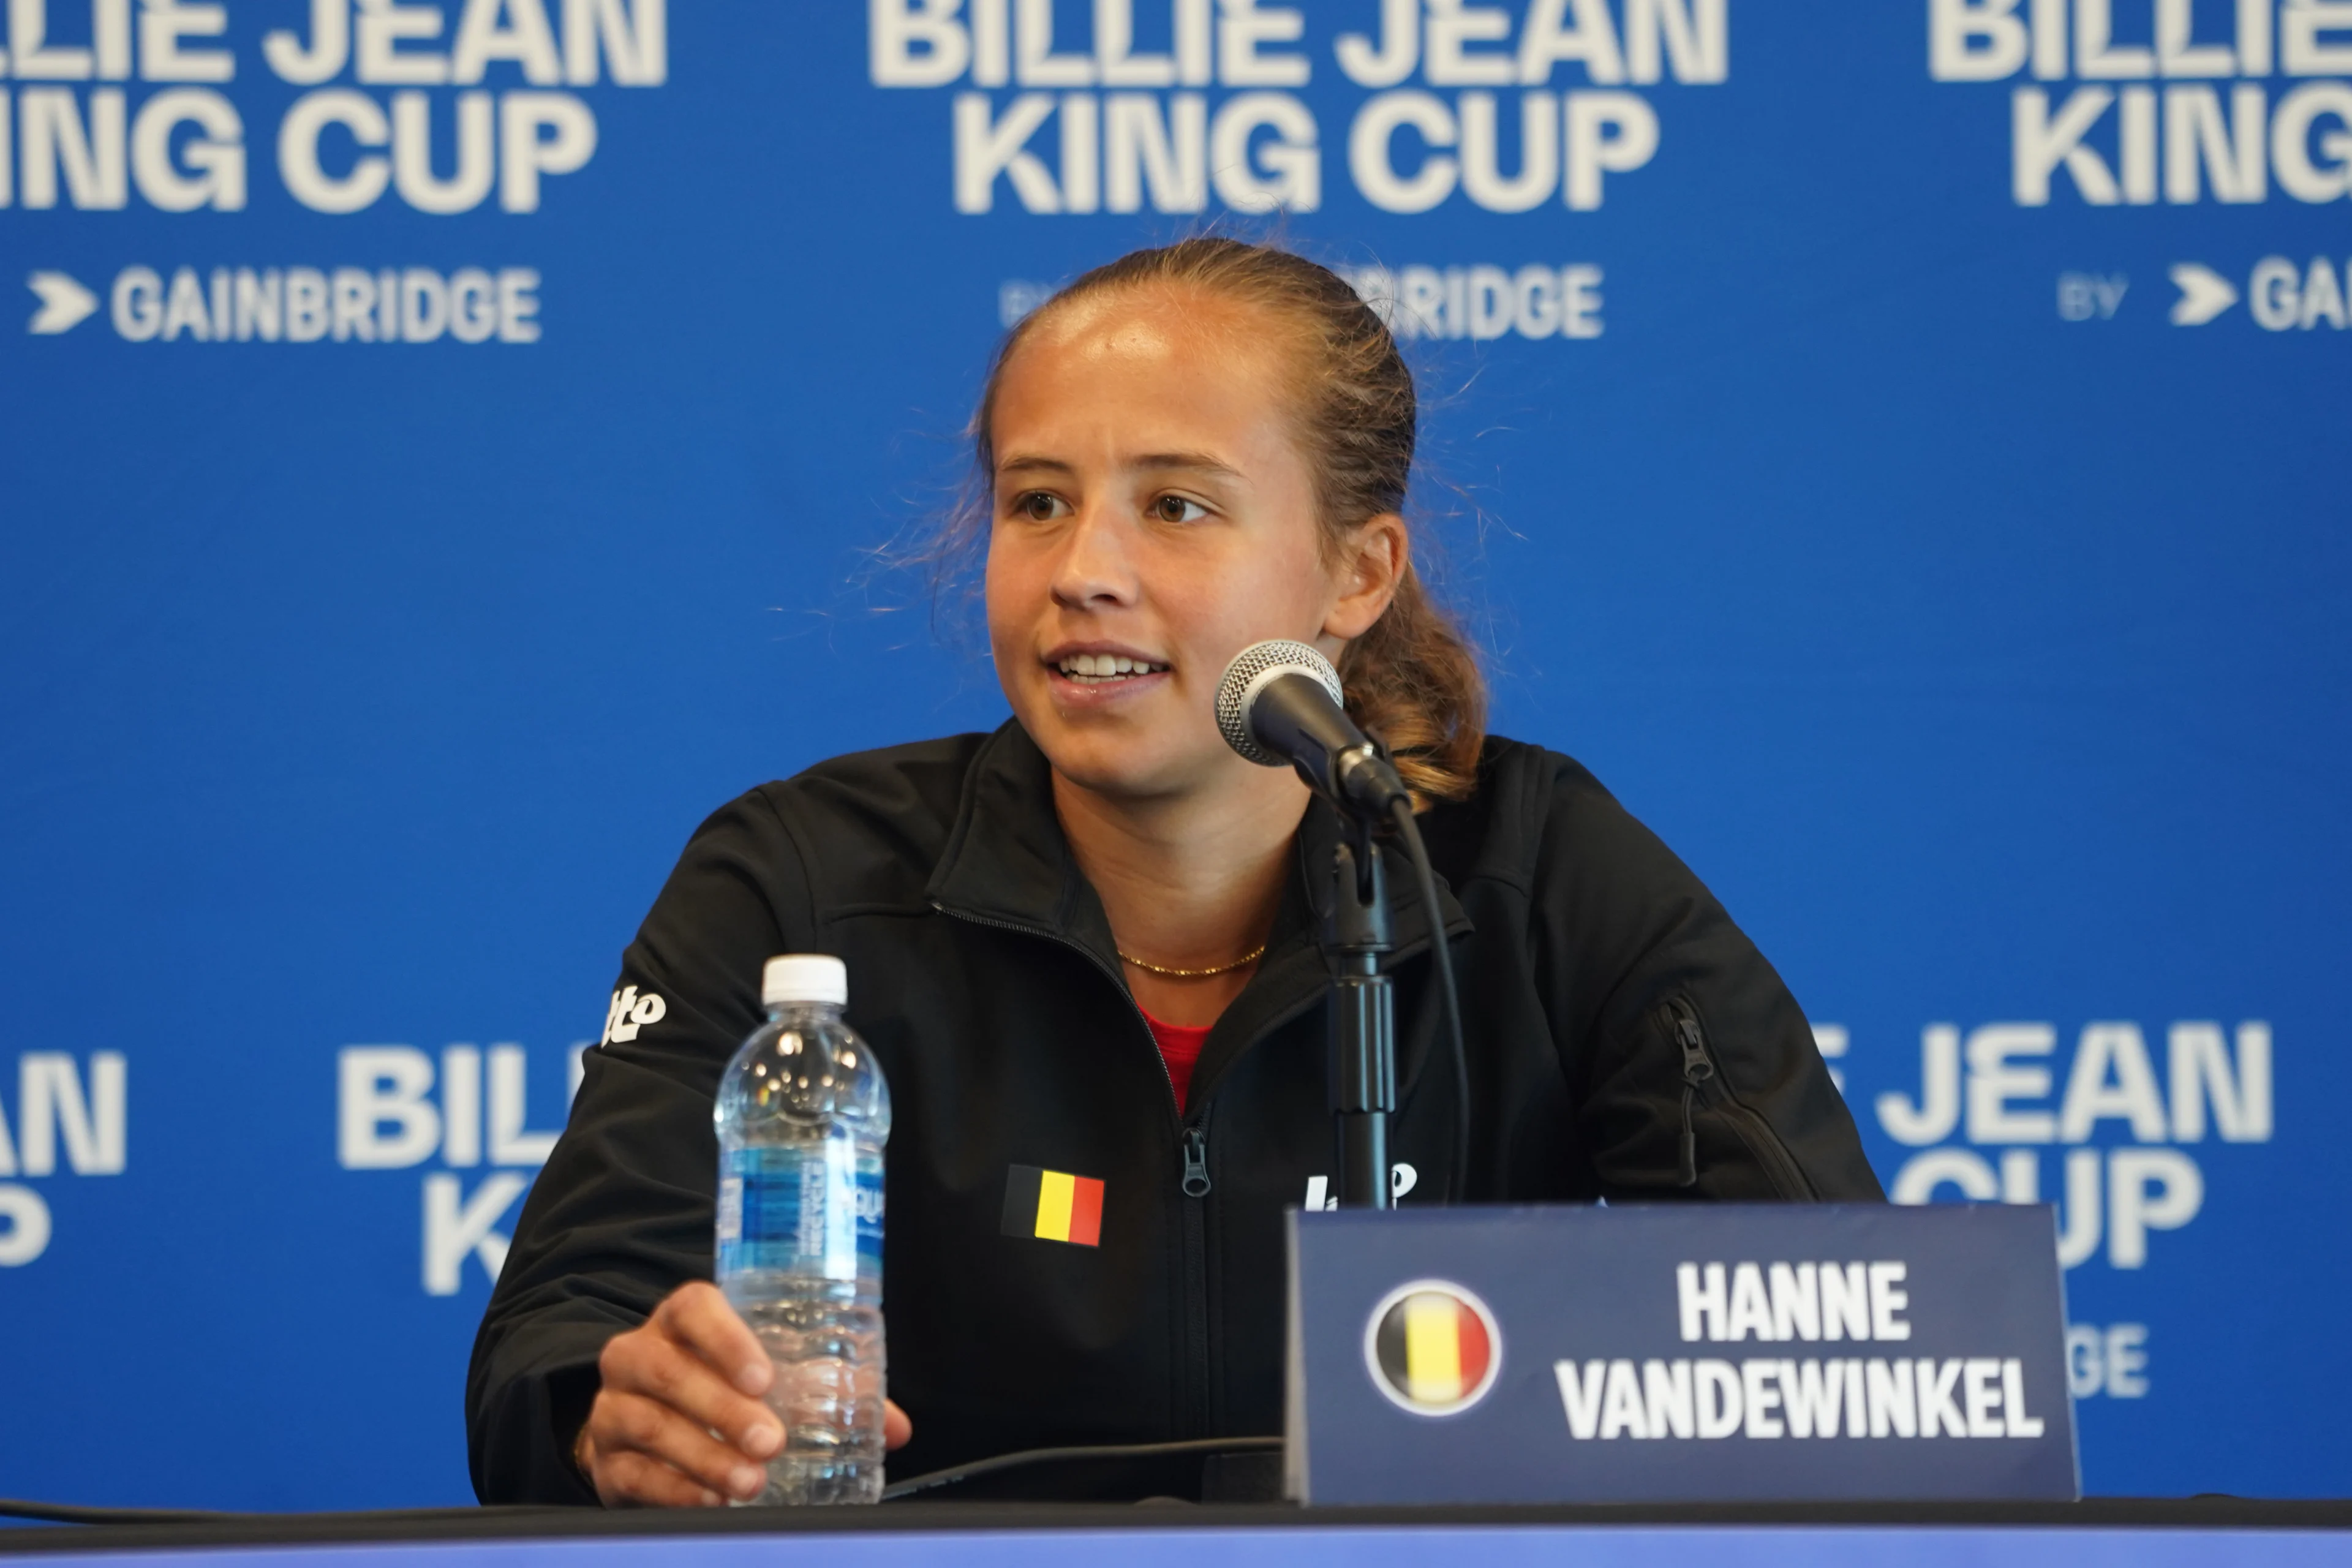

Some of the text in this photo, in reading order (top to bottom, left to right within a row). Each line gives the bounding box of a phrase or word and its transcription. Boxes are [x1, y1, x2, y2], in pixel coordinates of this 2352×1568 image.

[0, 0, 668, 88] LIE JEAN
[867, 0, 1730, 88] BILLIE JEAN
[277, 86, 599, 215] CUP
[952, 90, 1661, 215] KING CUP
[111, 266, 541, 344] GAINBRIDGE
[2056, 270, 2130, 322] BY
[337, 1042, 586, 1170] BIL
[1874, 1021, 2275, 1147] JEAN
[1675, 1260, 1912, 1343] HANNE
[1552, 1357, 2046, 1441] VANDEWINKEL
